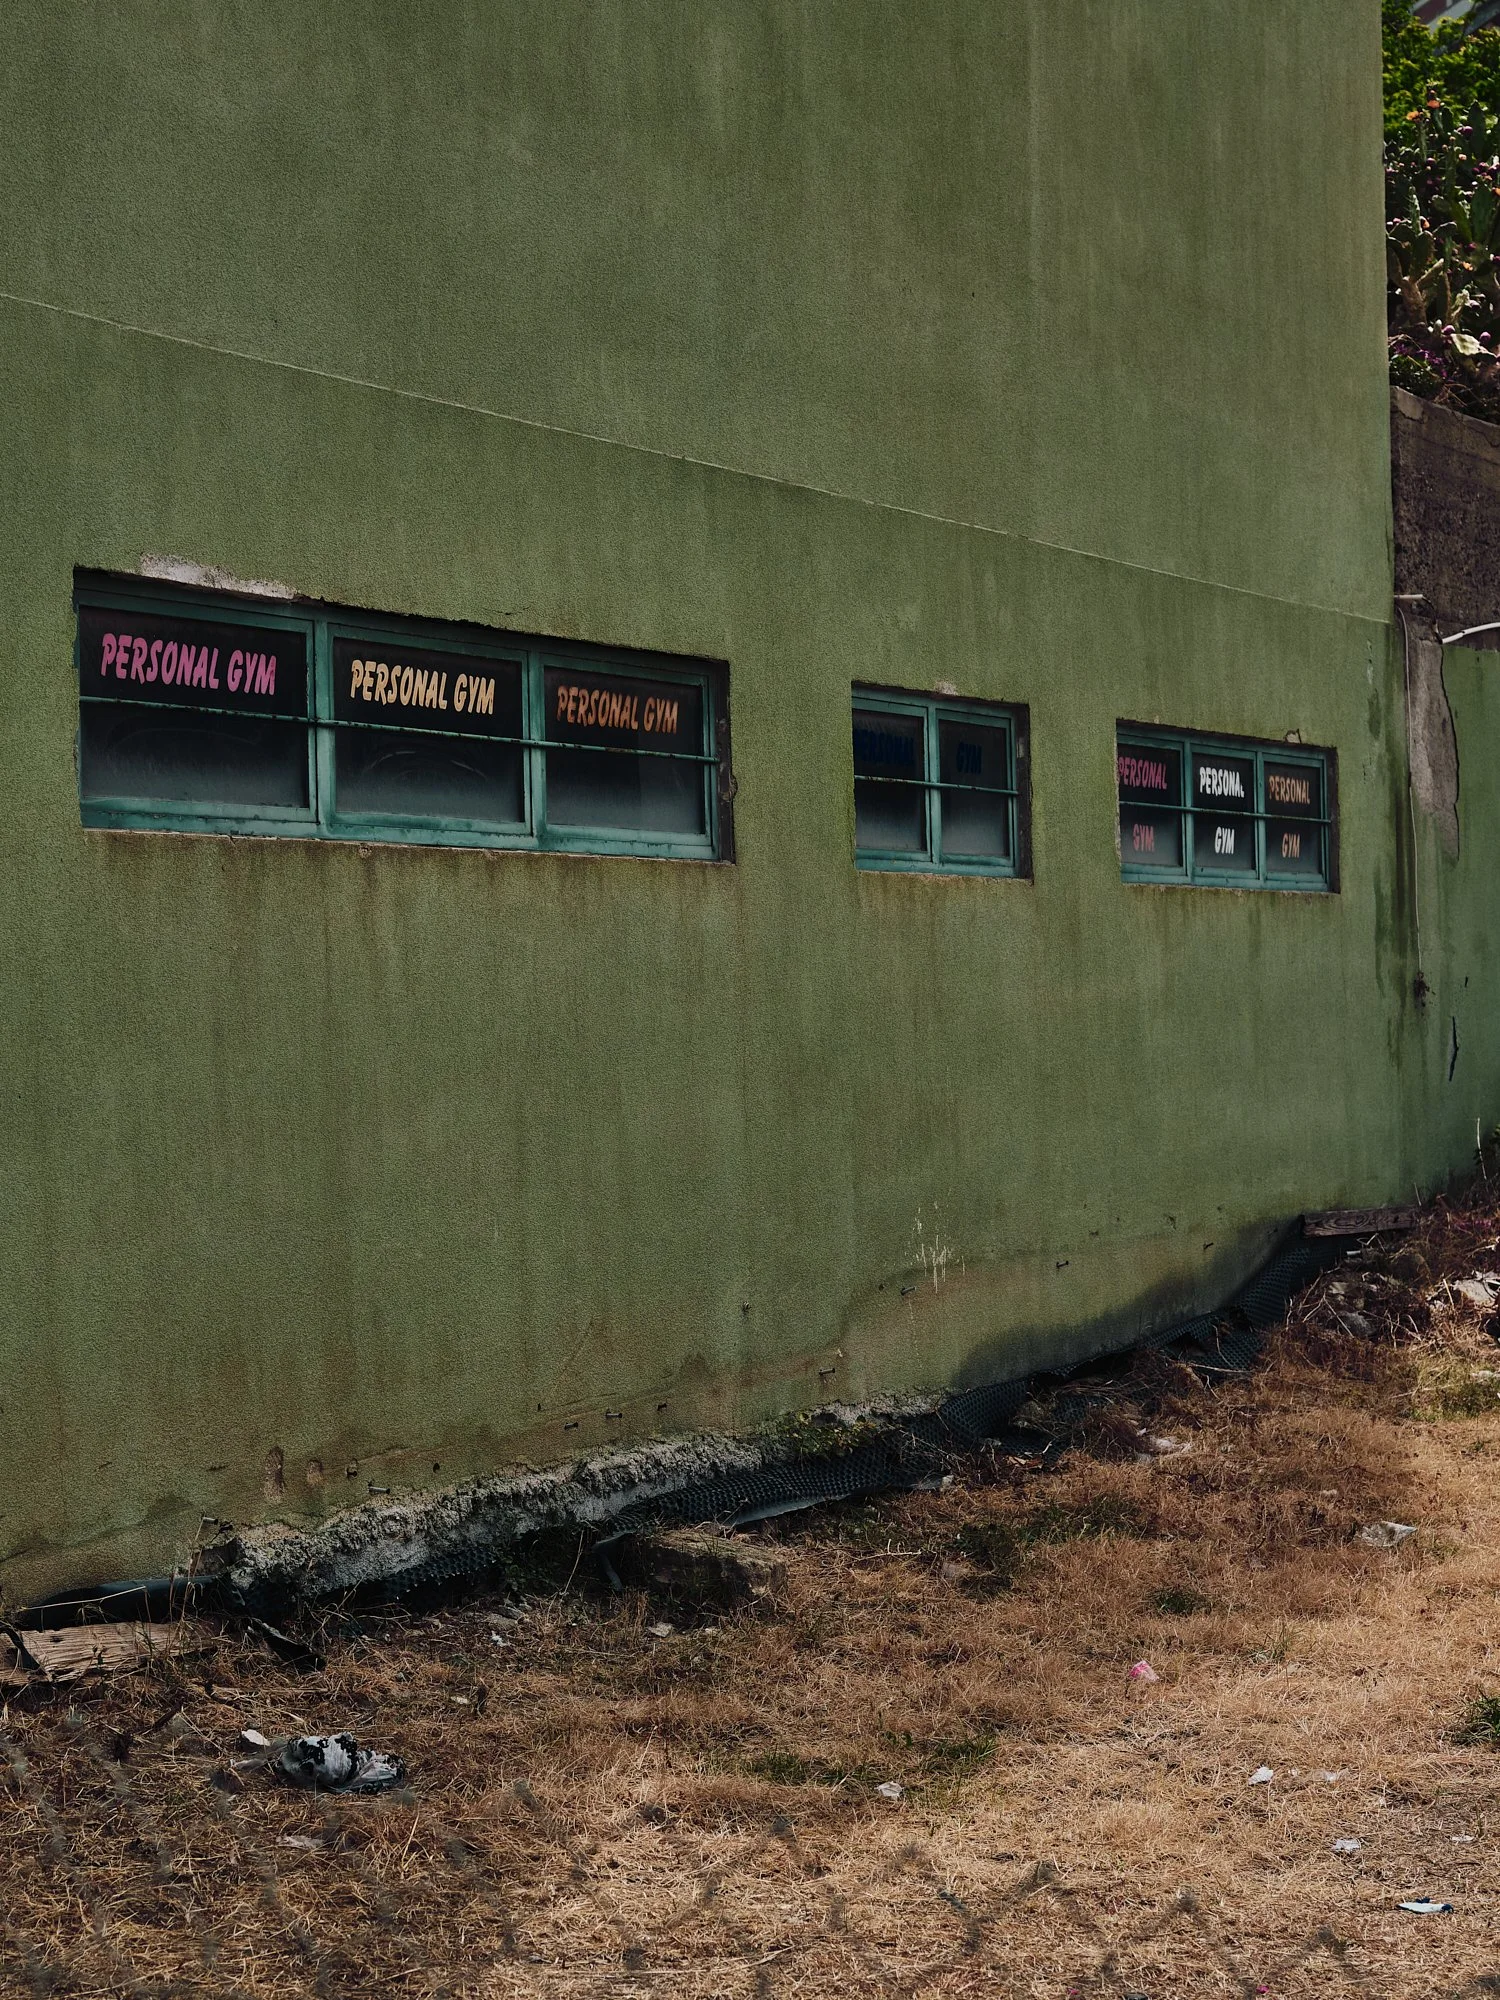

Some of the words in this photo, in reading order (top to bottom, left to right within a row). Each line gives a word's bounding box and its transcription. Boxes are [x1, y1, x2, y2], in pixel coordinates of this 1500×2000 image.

[101, 633, 220, 689] PERSONAL
[227, 650, 277, 695] GYM
[350, 659, 448, 710] PERSONAL
[453, 673, 496, 715] GYM
[556, 685, 639, 732] PERSONAL
[643, 697, 678, 734] GYM
[957, 742, 982, 775] GYM
[1118, 757, 1168, 790] PERSONAL
[1268, 775, 1311, 805] PERSONAL
[1133, 823, 1154, 852] GYM
[1214, 826, 1235, 855] GYM
[1281, 832, 1300, 858] GYM
